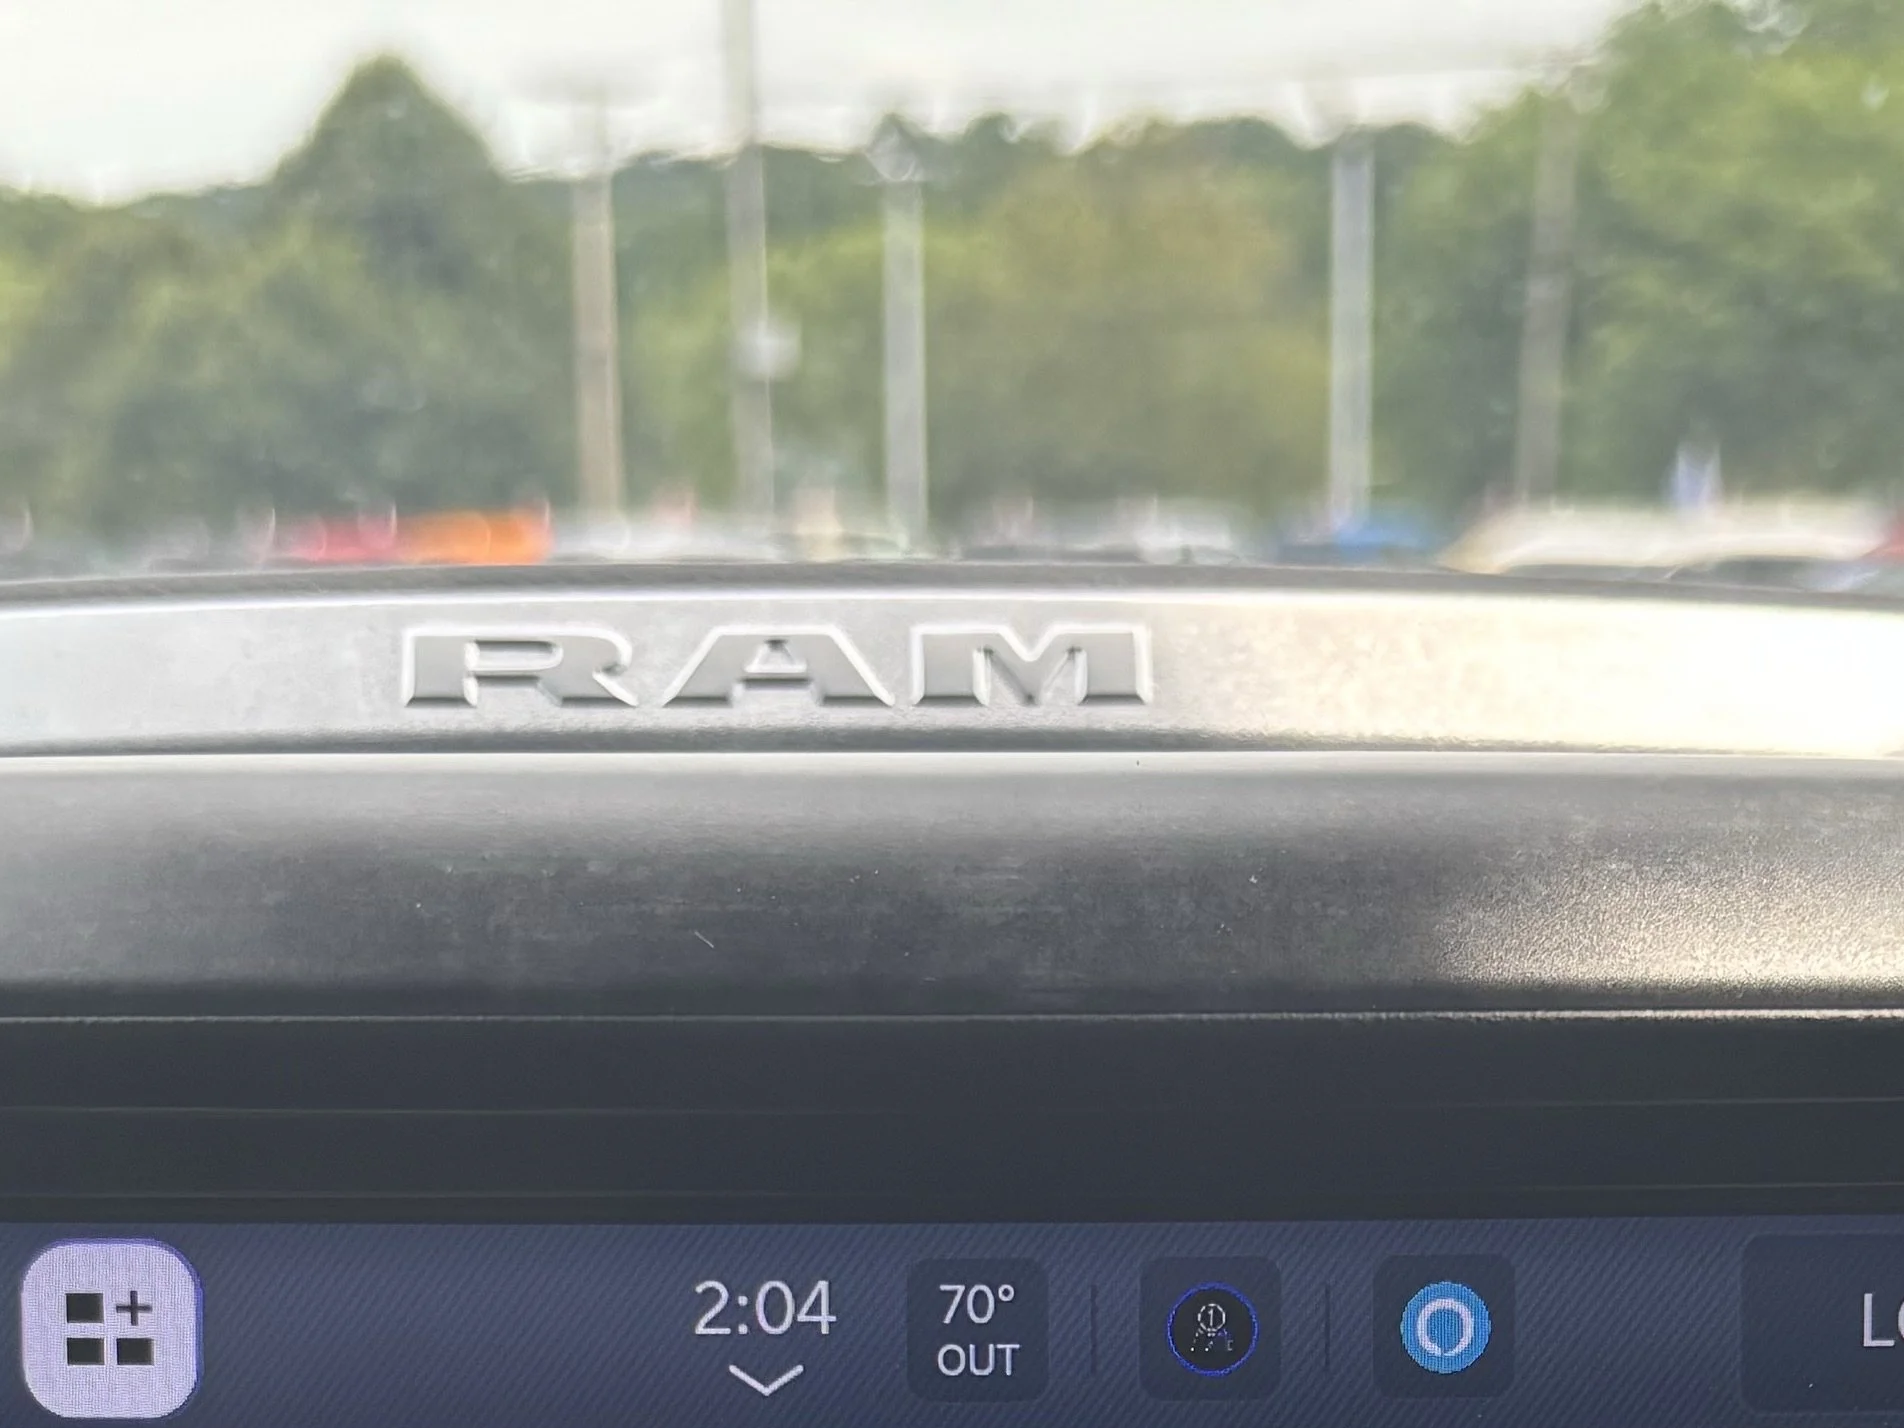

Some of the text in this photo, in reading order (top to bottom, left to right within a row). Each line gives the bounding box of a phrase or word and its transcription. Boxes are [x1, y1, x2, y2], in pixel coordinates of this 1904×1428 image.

[401, 623, 1153, 708] RAM
[695, 1281, 836, 1335] 2:04
[938, 1284, 1015, 1324] 70°
[938, 1344, 1020, 1376] OUT
